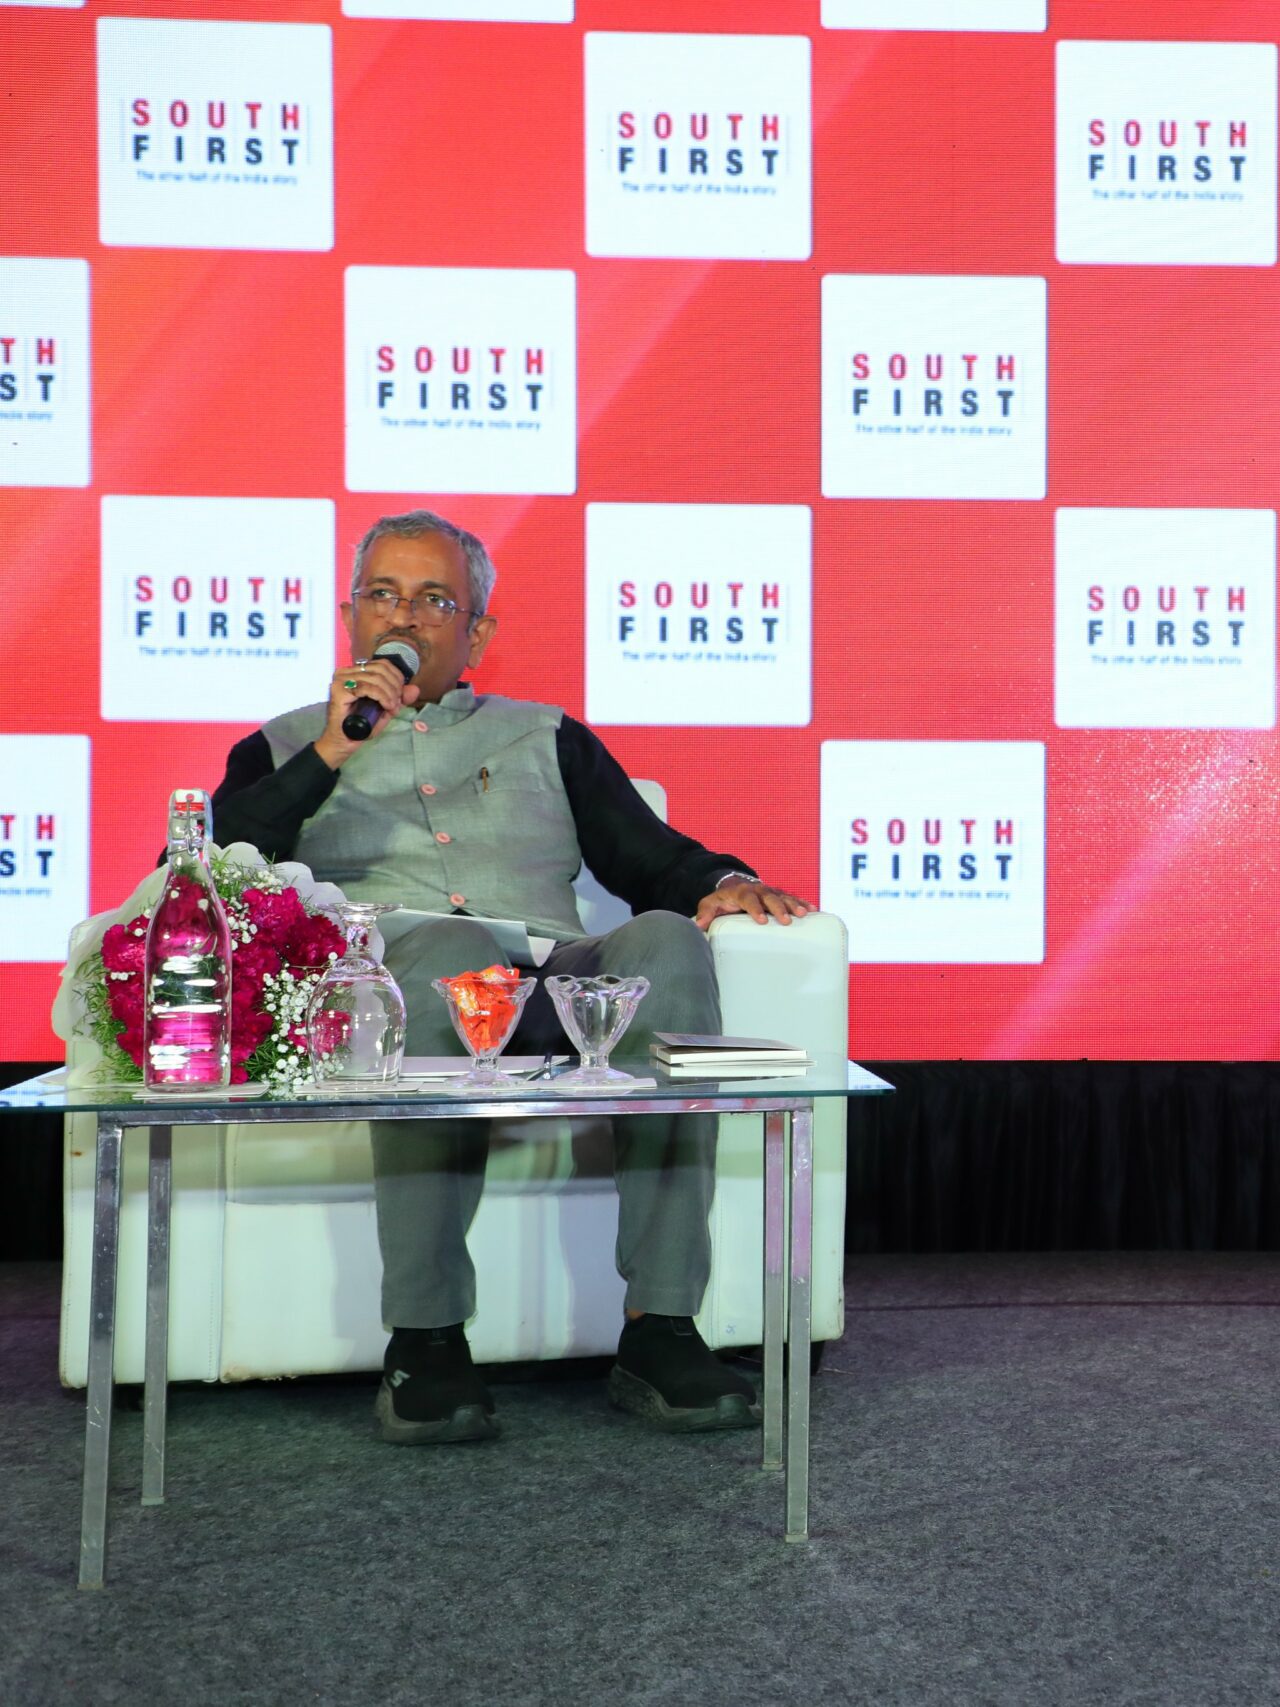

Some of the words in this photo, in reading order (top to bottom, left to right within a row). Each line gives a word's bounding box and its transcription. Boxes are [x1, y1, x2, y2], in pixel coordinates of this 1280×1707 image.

[132, 98, 300, 130] SOUTH
[618, 112, 779, 140] SOUTH
[1089, 119, 1247, 148] SOUTH
[132, 134, 299, 165] FIRST
[618, 147, 779, 175] FIRST
[136, 170, 154, 181] The
[1088, 154, 1246, 182] FIRST
[620, 182, 638, 193] The
[1092, 190, 1109, 198] The
[377, 346, 544, 374] SOUTH
[852, 353, 1015, 381] SOUTH
[378, 381, 543, 410] FIRST
[852, 388, 1014, 416] FIRST
[380, 417, 398, 427] The
[854, 425, 873, 433] The
[135, 576, 302, 604] SOUTH
[619, 582, 779, 608] SOUTH
[1088, 586, 1245, 612] SOUTH
[135, 611, 301, 639] FIRST
[619, 616, 778, 643] FIRST
[1088, 620, 1244, 646] FIRST
[138, 646, 156, 655] The
[622, 651, 639, 660] The
[1090, 656, 1108, 664] The
[851, 819, 1013, 845] SOUTH
[851, 853, 1012, 881] FIRST
[852, 890, 871, 899] The
